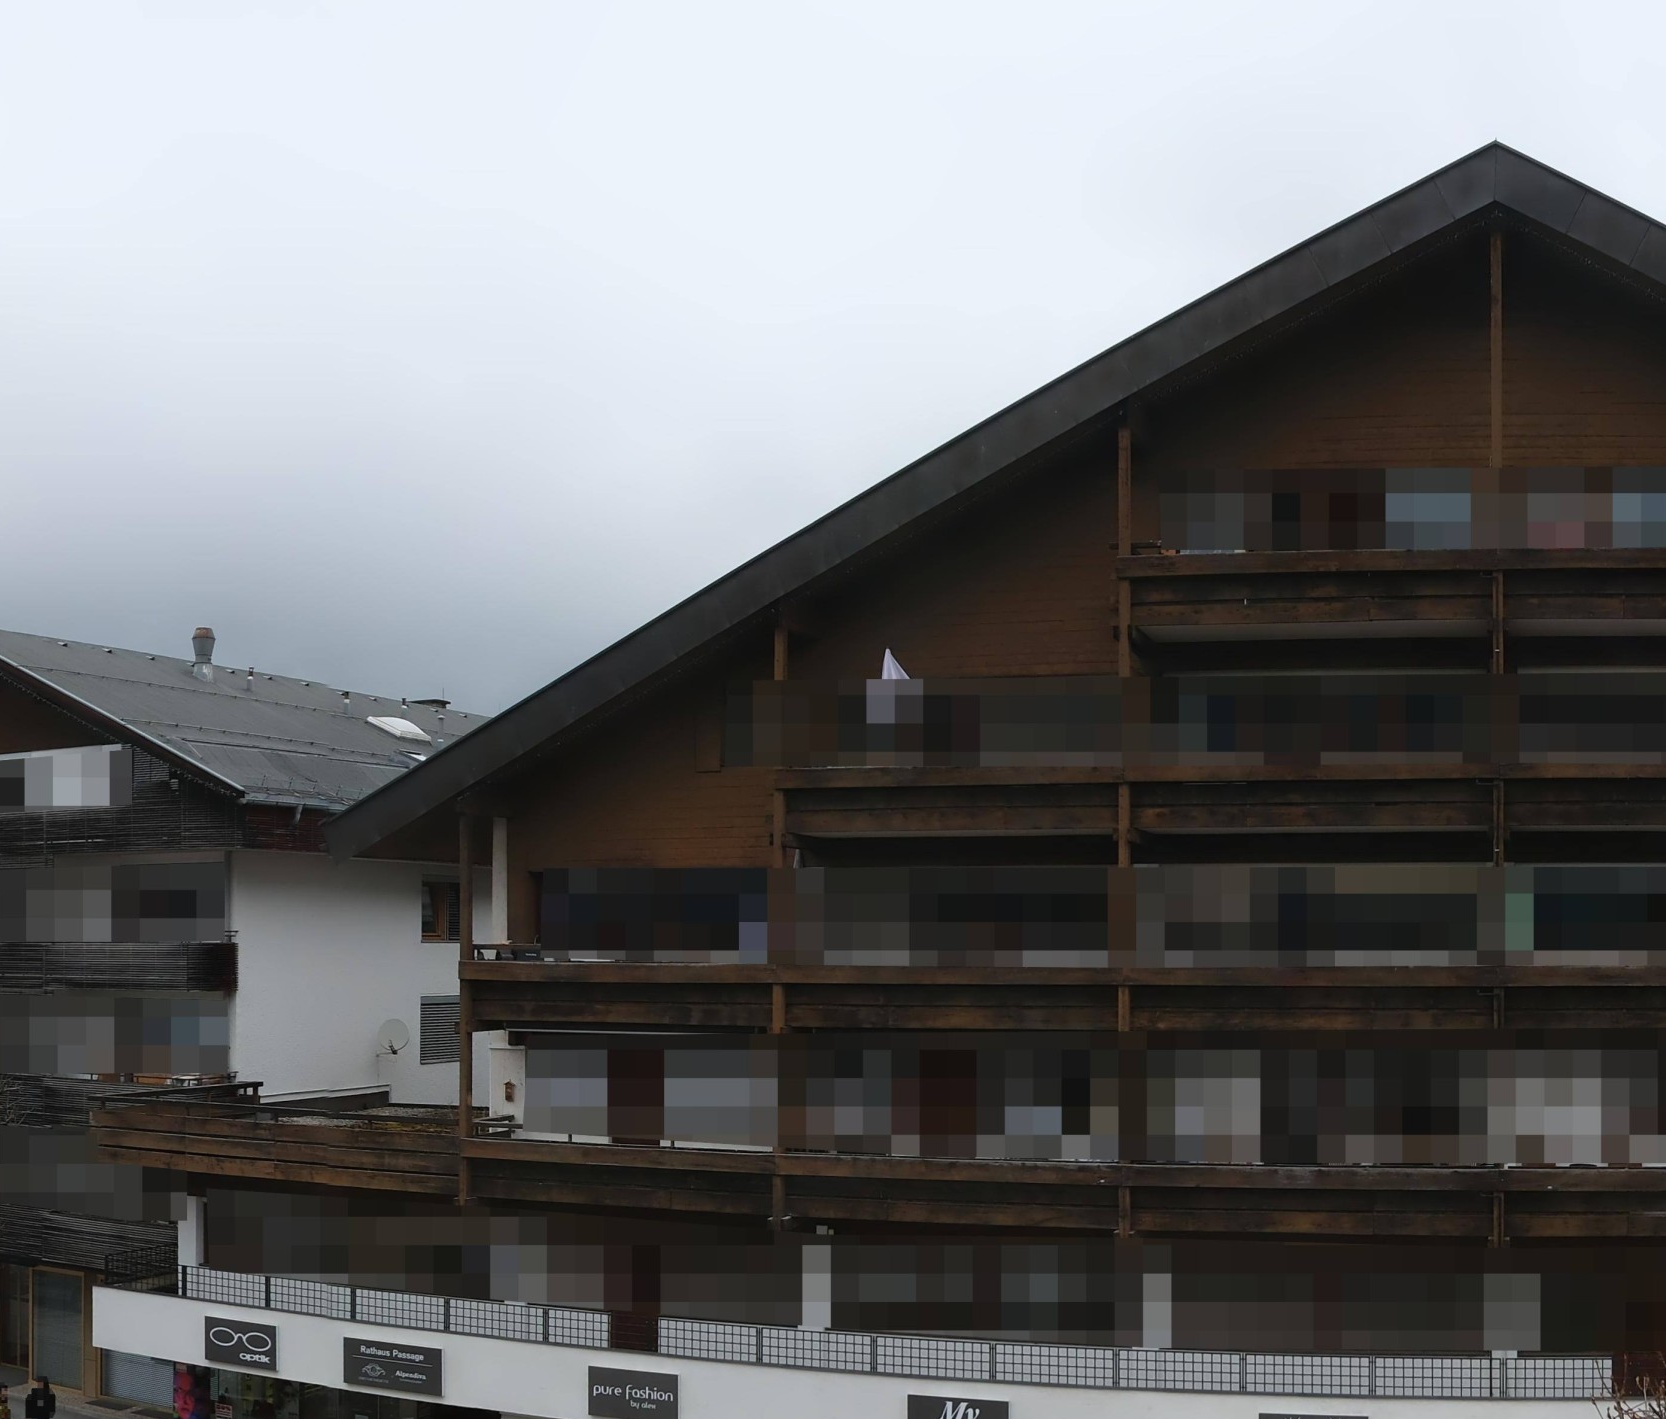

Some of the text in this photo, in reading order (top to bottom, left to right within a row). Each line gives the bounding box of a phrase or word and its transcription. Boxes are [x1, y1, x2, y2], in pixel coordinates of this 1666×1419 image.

[239, 1352, 271, 1364] optik
[360, 1345, 425, 1362] Rathaus Passage
[593, 1384, 674, 1402] pure fashion
[629, 1400, 657, 1410] by alex
